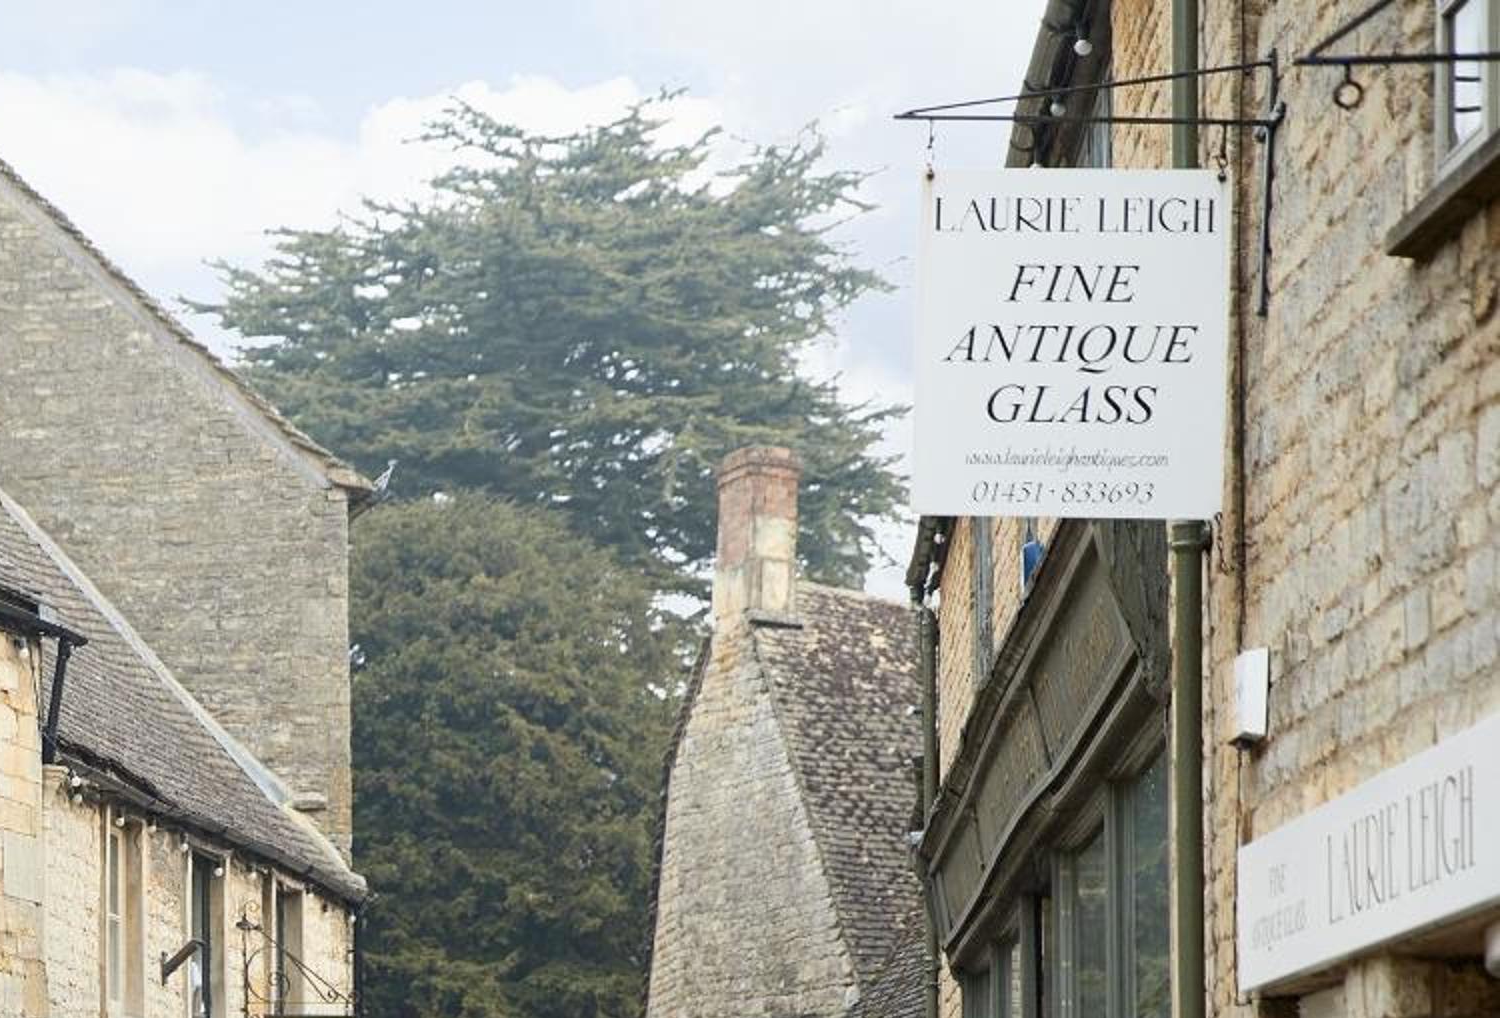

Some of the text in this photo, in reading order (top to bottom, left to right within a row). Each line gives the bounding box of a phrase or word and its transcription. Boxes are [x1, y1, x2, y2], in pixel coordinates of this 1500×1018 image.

[934, 196, 1217, 233] LAURIE LEIGH
[1004, 263, 1140, 303] FINE
[943, 323, 1199, 375] ANTIQUE
[986, 384, 1158, 425] GLASS
[1325, 765, 1477, 926] LAURIE LEIGH
